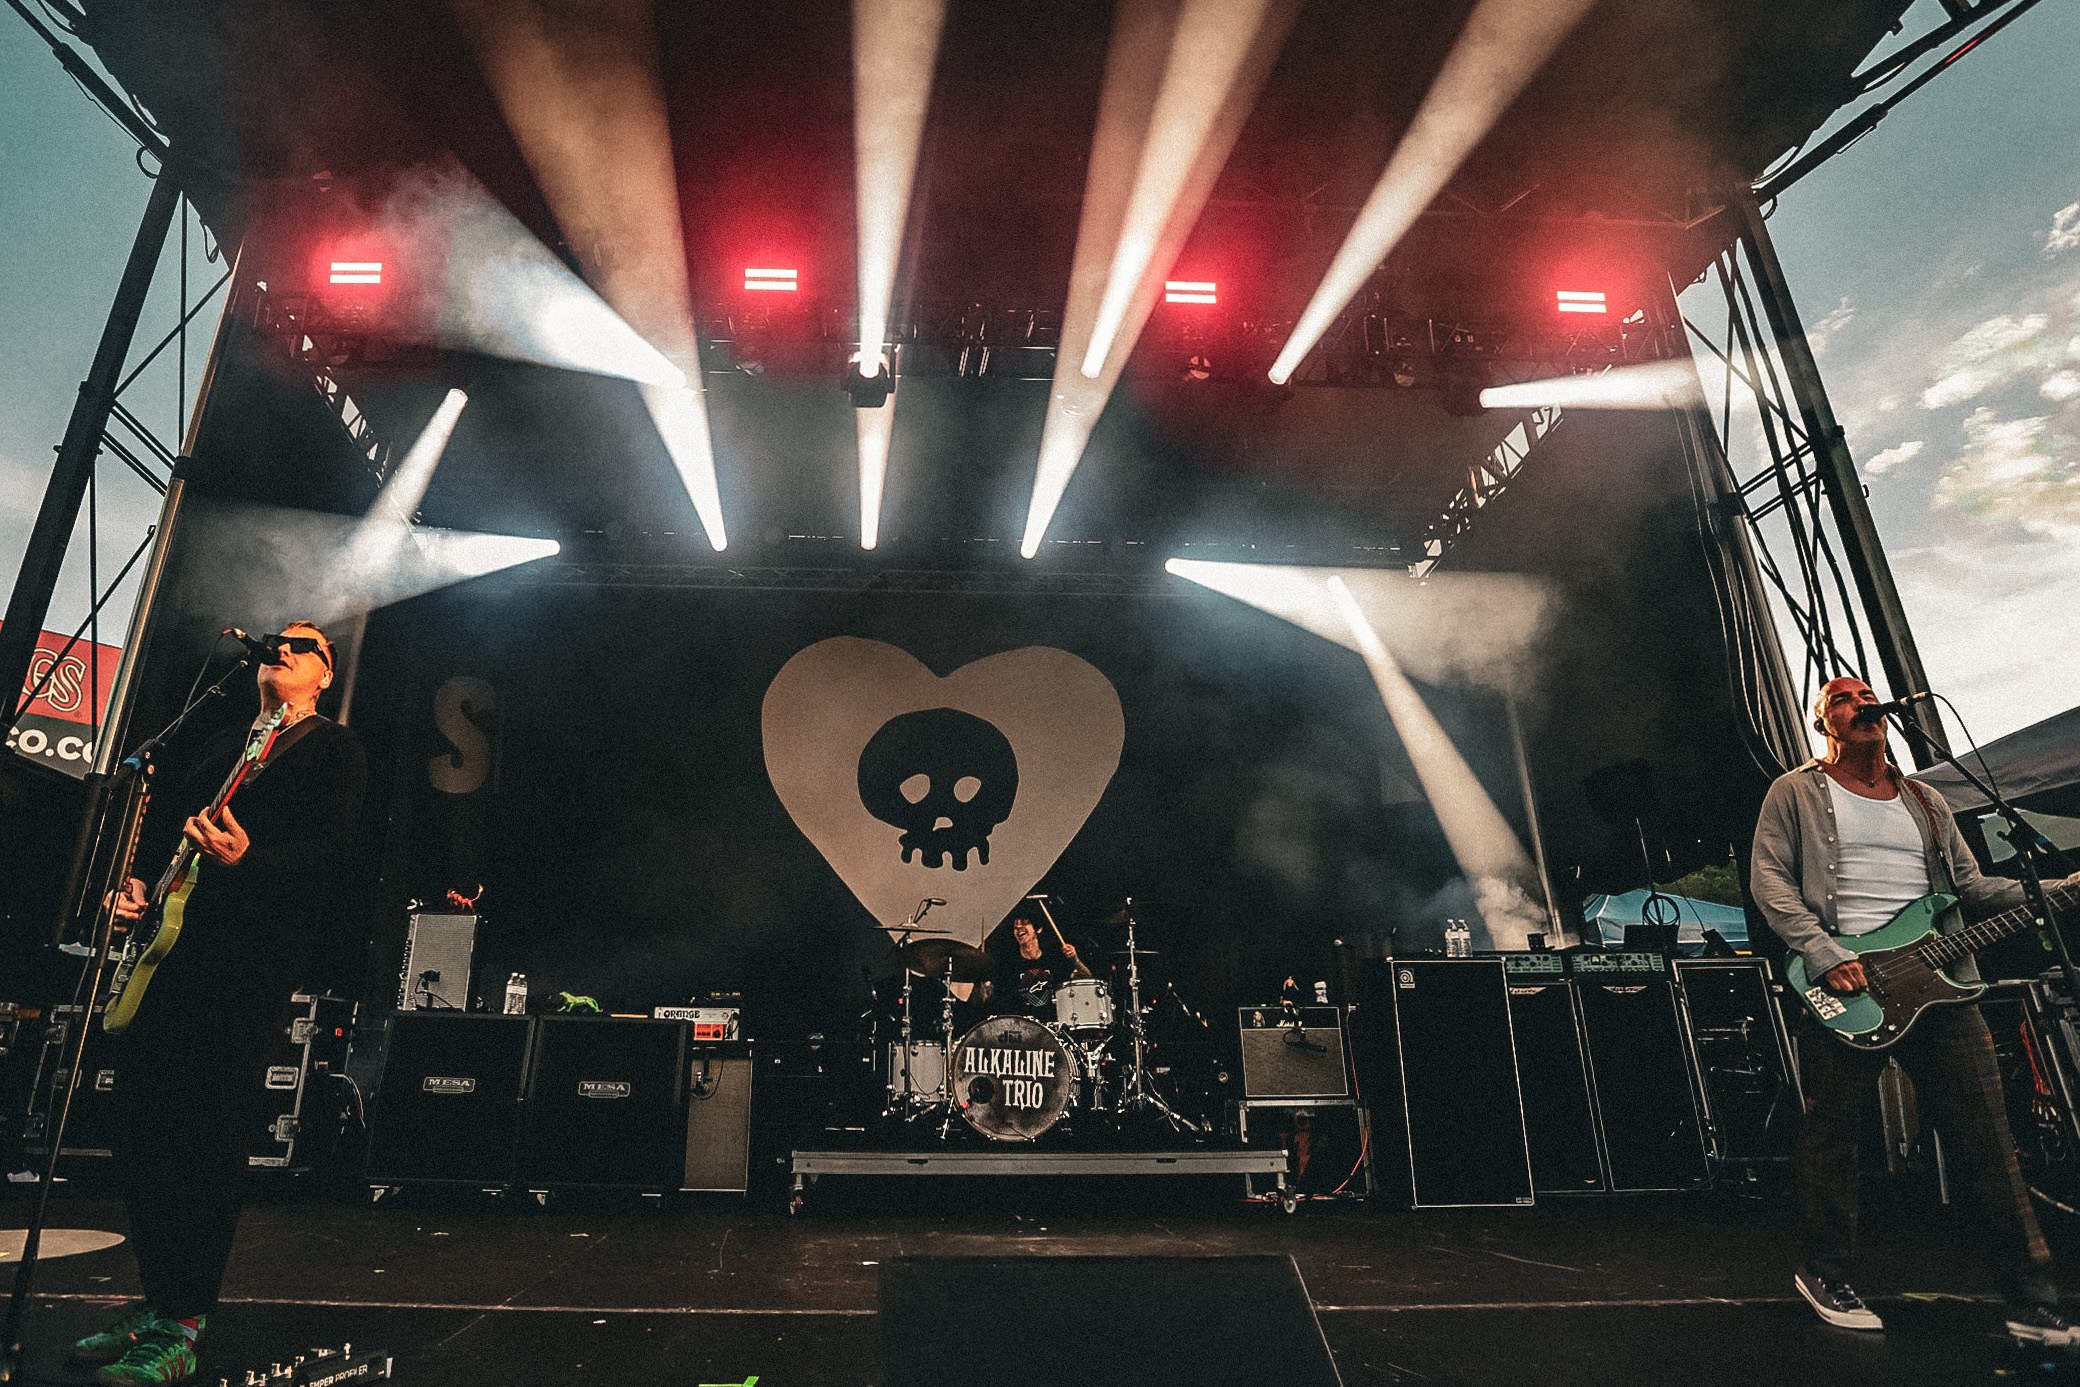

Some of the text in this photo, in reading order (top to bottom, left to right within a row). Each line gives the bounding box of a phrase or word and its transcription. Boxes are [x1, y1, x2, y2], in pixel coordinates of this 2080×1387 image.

[964, 1047, 1055, 1080] ALKALINE
[428, 1078, 470, 1087] MESA
[583, 1083, 625, 1092] MESA
[1003, 1080, 1043, 1110] TRIO
